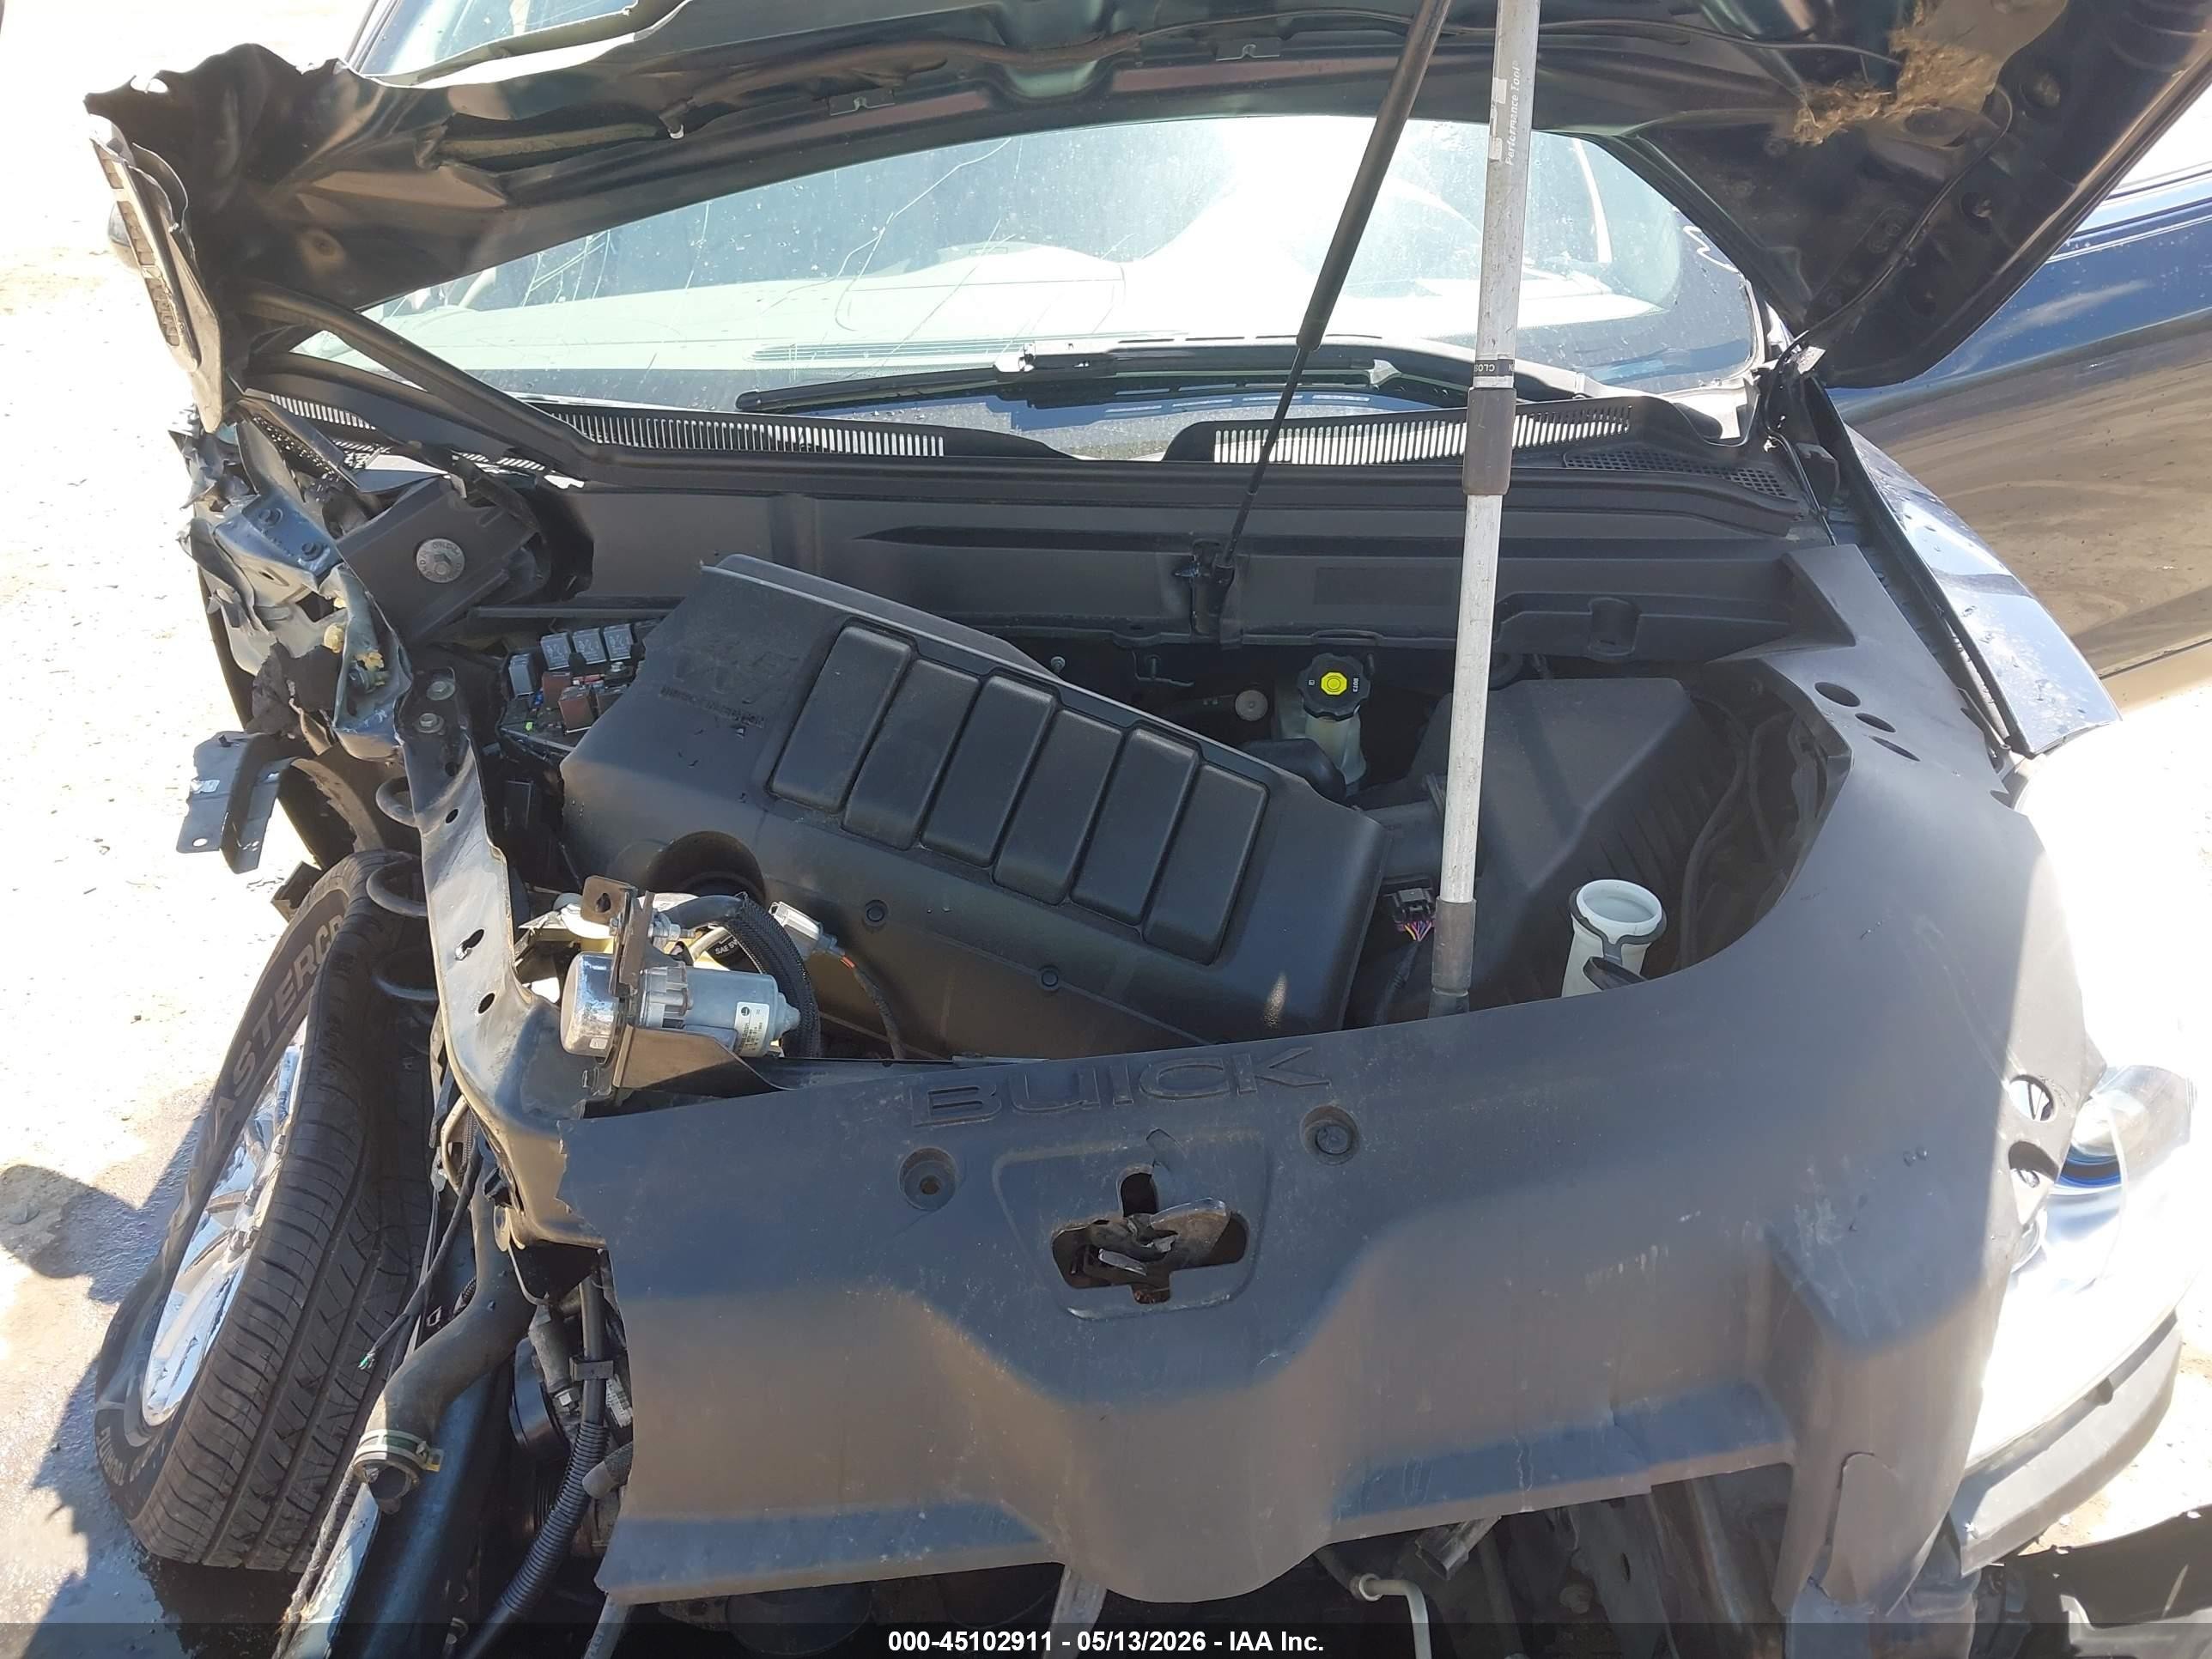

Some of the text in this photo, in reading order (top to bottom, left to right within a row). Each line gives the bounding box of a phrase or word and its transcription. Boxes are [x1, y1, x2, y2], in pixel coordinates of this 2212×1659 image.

[1505, 94, 1518, 166] Performance
[714, 945, 729, 955] SAE
[910, 1046, 1331, 1127] BUICK
